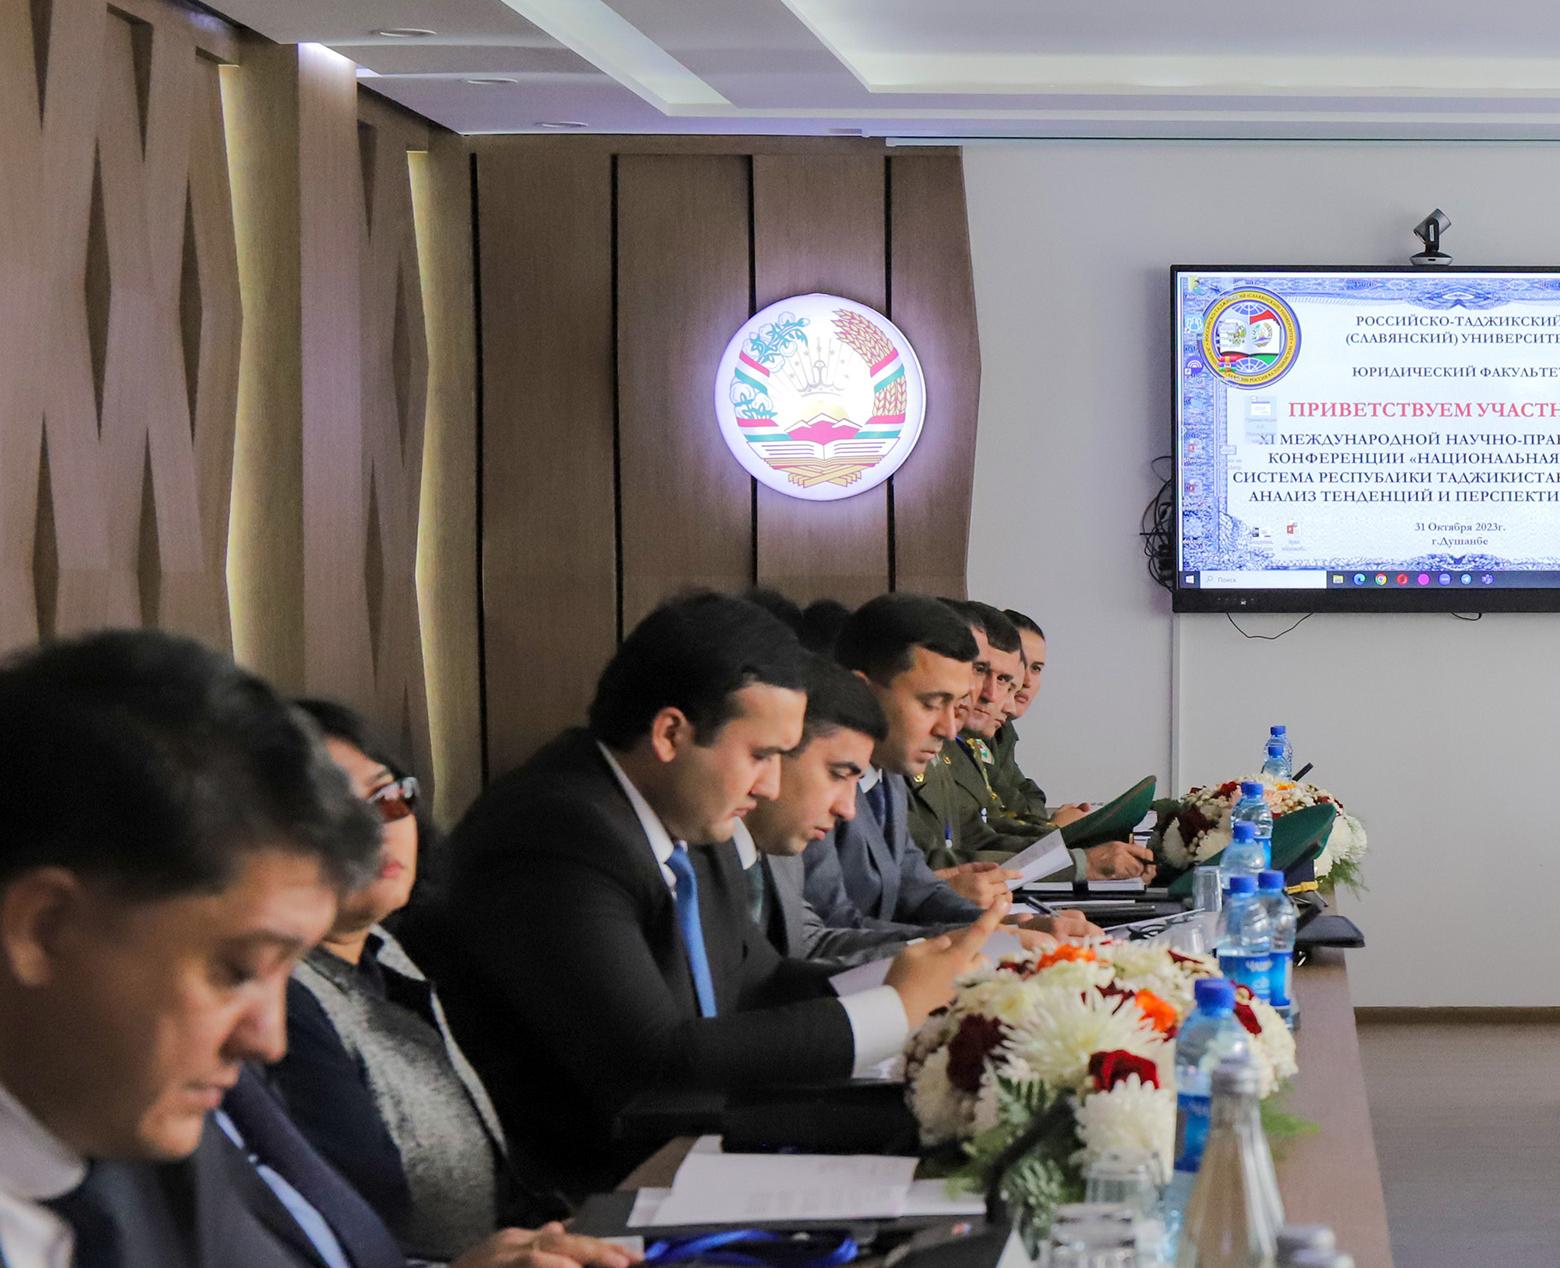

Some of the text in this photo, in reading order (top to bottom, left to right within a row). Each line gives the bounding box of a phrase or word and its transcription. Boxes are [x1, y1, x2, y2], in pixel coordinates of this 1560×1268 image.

[1345, 332, 1459, 346] (СЛАВЯНСКИЙ)
[1352, 365, 1477, 378] ЮРИДИЧЕСКИЙ
[1289, 402, 1472, 417] ПРИВЕТСТВУЕМ
[1280, 432, 1441, 446] МЕЖДУНАРОДНОЙ
[1268, 452, 1405, 466] КОНФЕРЕНЦИИ
[1409, 452, 1559, 466] «НАЦИОНАЛЬНАЯ
[1232, 471, 1313, 484] СИСТЕМА
[1318, 471, 1432, 484] РЕСПУБЛИКИ
[1248, 490, 1317, 503] АНАЛИЗ
[1320, 488, 1433, 504] ТЕНДЕНЦИЙ
[1438, 490, 1450, 502] И
[1415, 522, 1506, 534] 31 Октября 2023г.
[1431, 536, 1489, 548] г.Душанбе
